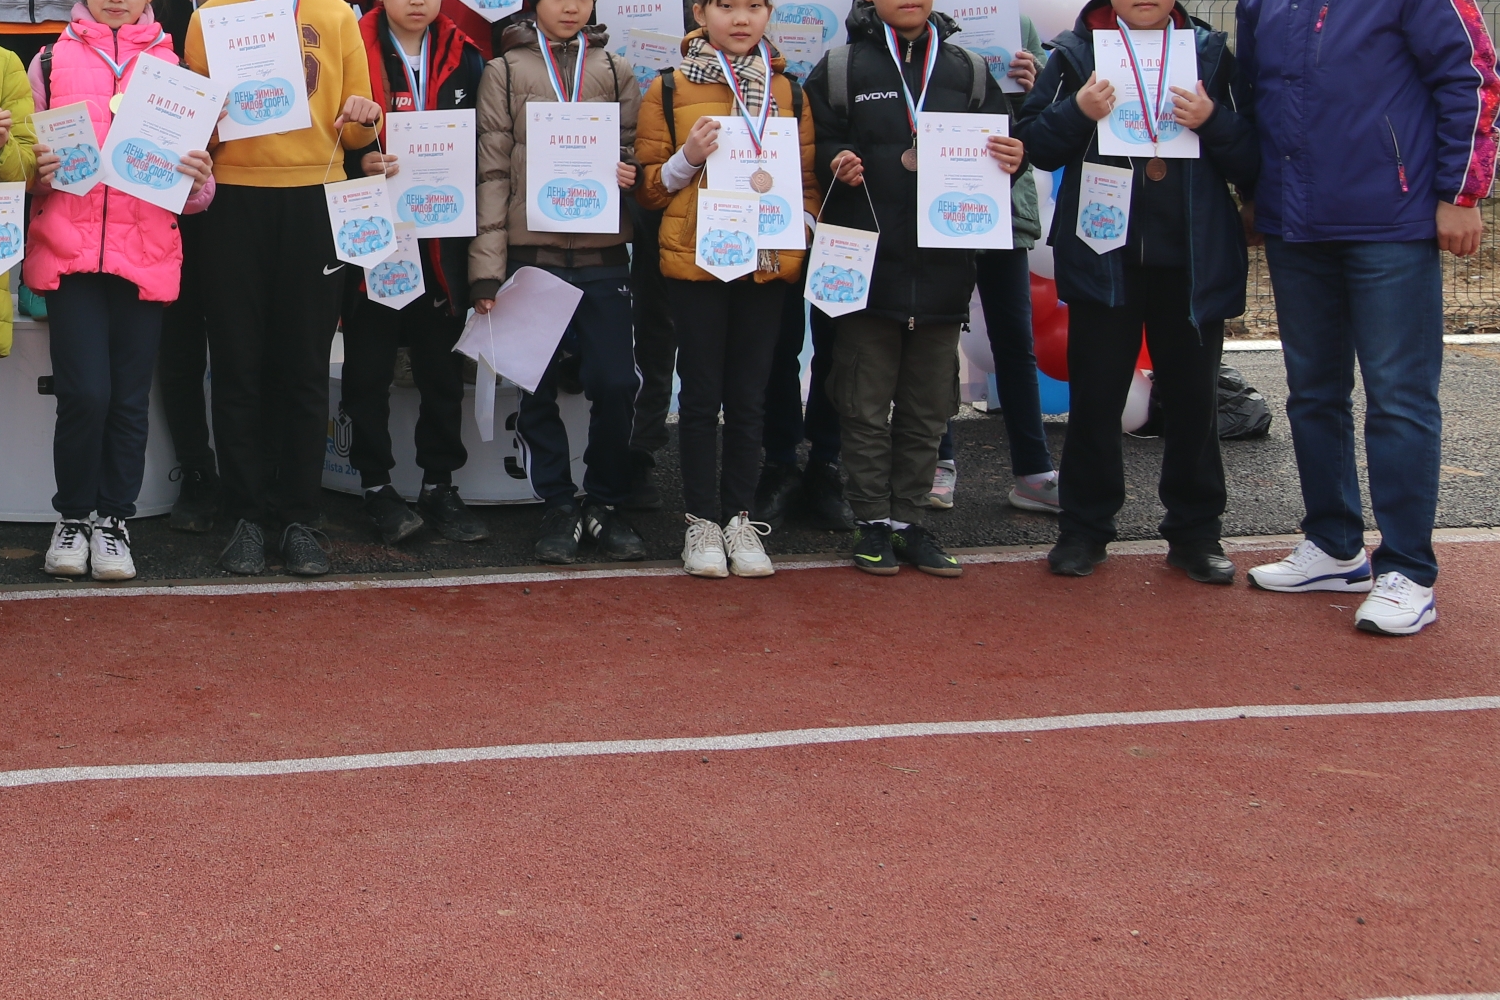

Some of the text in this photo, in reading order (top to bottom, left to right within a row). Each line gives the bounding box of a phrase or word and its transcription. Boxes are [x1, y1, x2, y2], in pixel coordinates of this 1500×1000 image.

[618, 4, 662, 15] ДИПЛОМ
[953, 6, 998, 19] ДИПЛОМ
[228, 32, 276, 50] ДИПЛОМ
[234, 88, 284, 105] ДЕНЬ ЗИМНИХ
[147, 93, 196, 119] ДИПЛОМ
[241, 97, 290, 110] ВИДОВ СПОРТА
[254, 108, 272, 119] 2020
[1119, 109, 1140, 121] ДЕНЬ
[549, 135, 597, 145] ДИПЛОМ
[408, 141, 455, 154] ДИПЛОМ
[940, 147, 988, 157] ДИПЛОМ
[123, 143, 175, 171] ДЕНЬ ЗИМНИХ
[126, 155, 175, 184] ВИДОВ СПОРТА
[134, 169, 152, 183] 2020
[757, 173, 763, 181] 3
[546, 186, 597, 199] ДЕНЬ ЗИМНИХ
[342, 195, 348, 203] 8
[406, 194, 454, 206] ДЕНЬ ЗИМНИХ
[551, 197, 601, 209] ВИДОВ СПОРТА
[410, 203, 458, 214] ВИДОВ СПОРТА
[564, 207, 581, 216] 2020
[713, 203, 718, 211] 8
[937, 200, 988, 213] ДЕНЬ ЗИМНИХ
[423, 213, 440, 222] 2020
[943, 212, 992, 225] ВИДОВ СПОРТА
[955, 222, 973, 231] 2020
[829, 238, 835, 247] 8
[323, 461, 343, 473] lista
